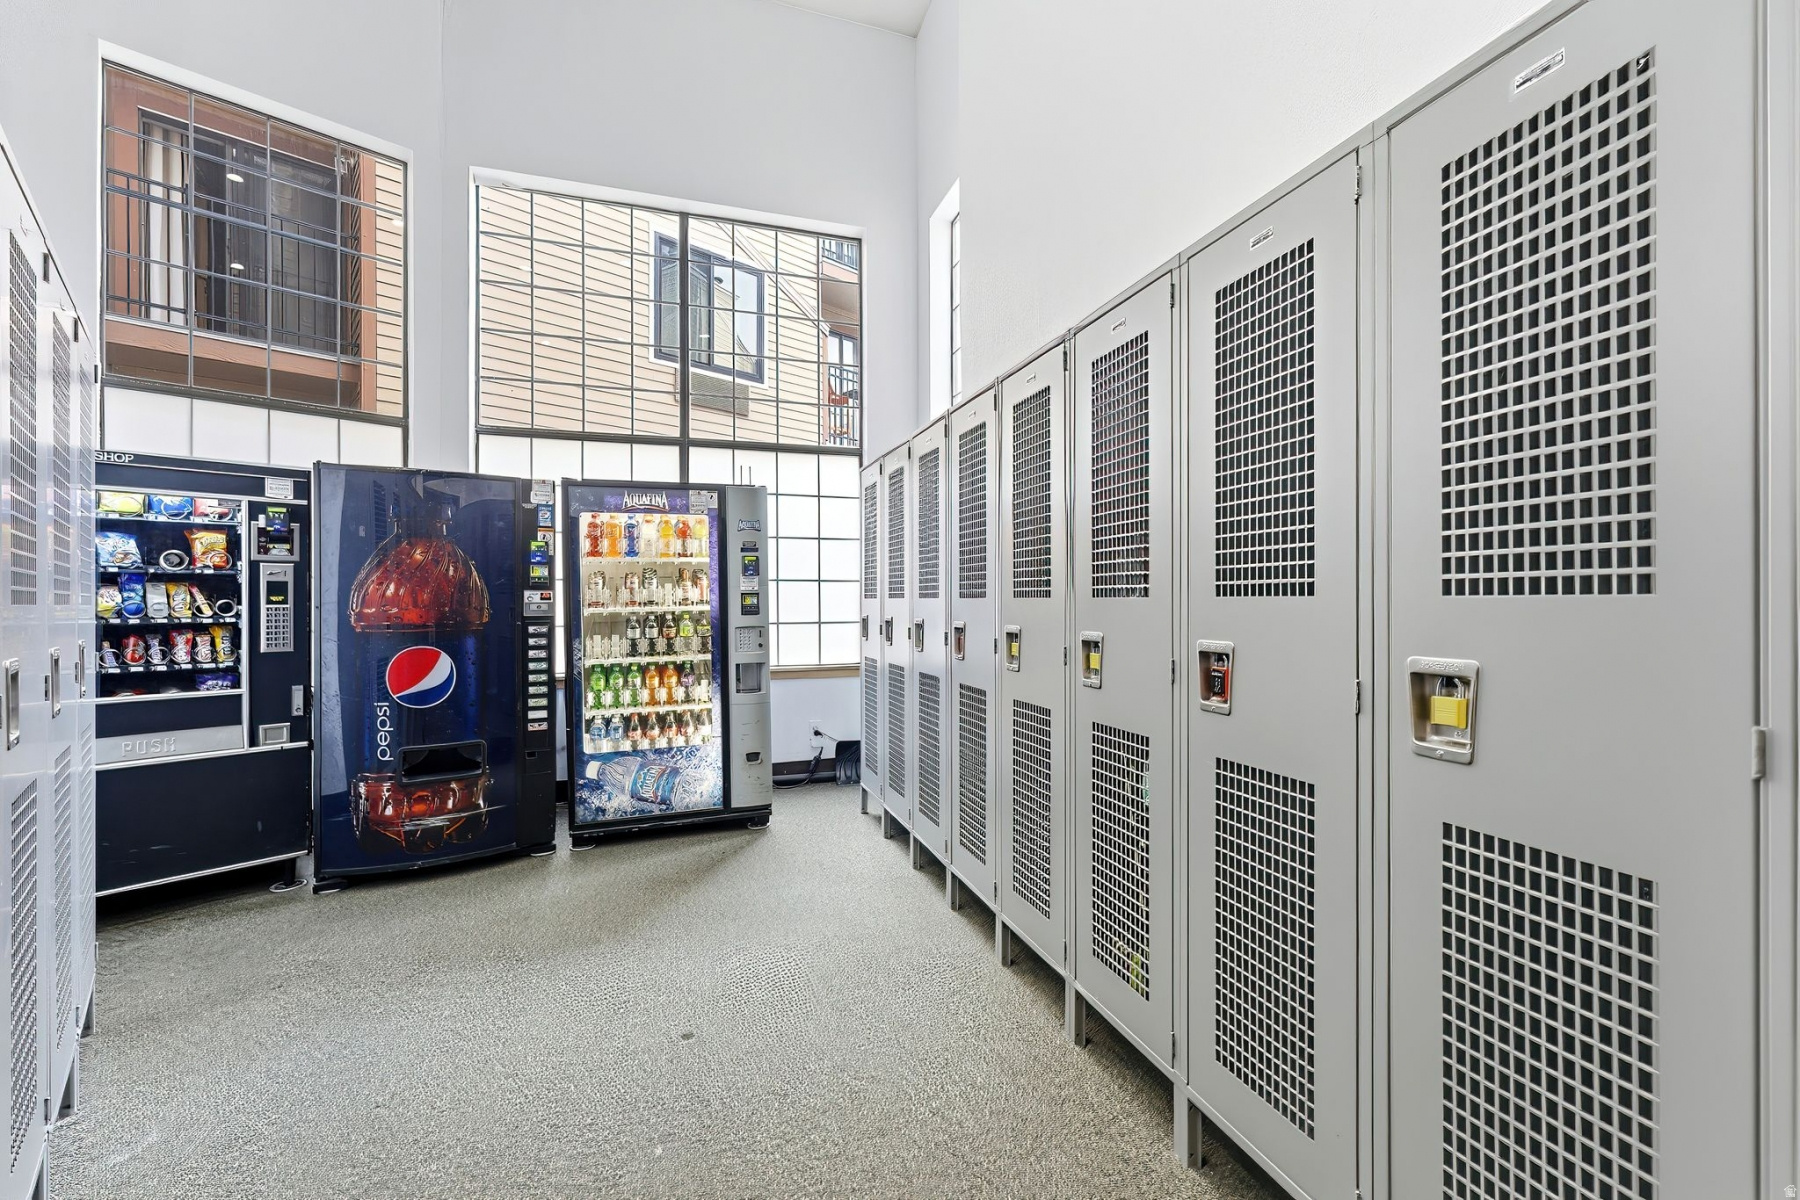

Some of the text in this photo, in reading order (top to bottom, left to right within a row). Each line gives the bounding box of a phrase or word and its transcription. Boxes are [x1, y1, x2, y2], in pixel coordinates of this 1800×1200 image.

[95, 452, 134, 463] SHOP
[622, 490, 669, 511] AQUAFINA
[373, 702, 394, 761] pepsi
[121, 737, 177, 757] PUSH
